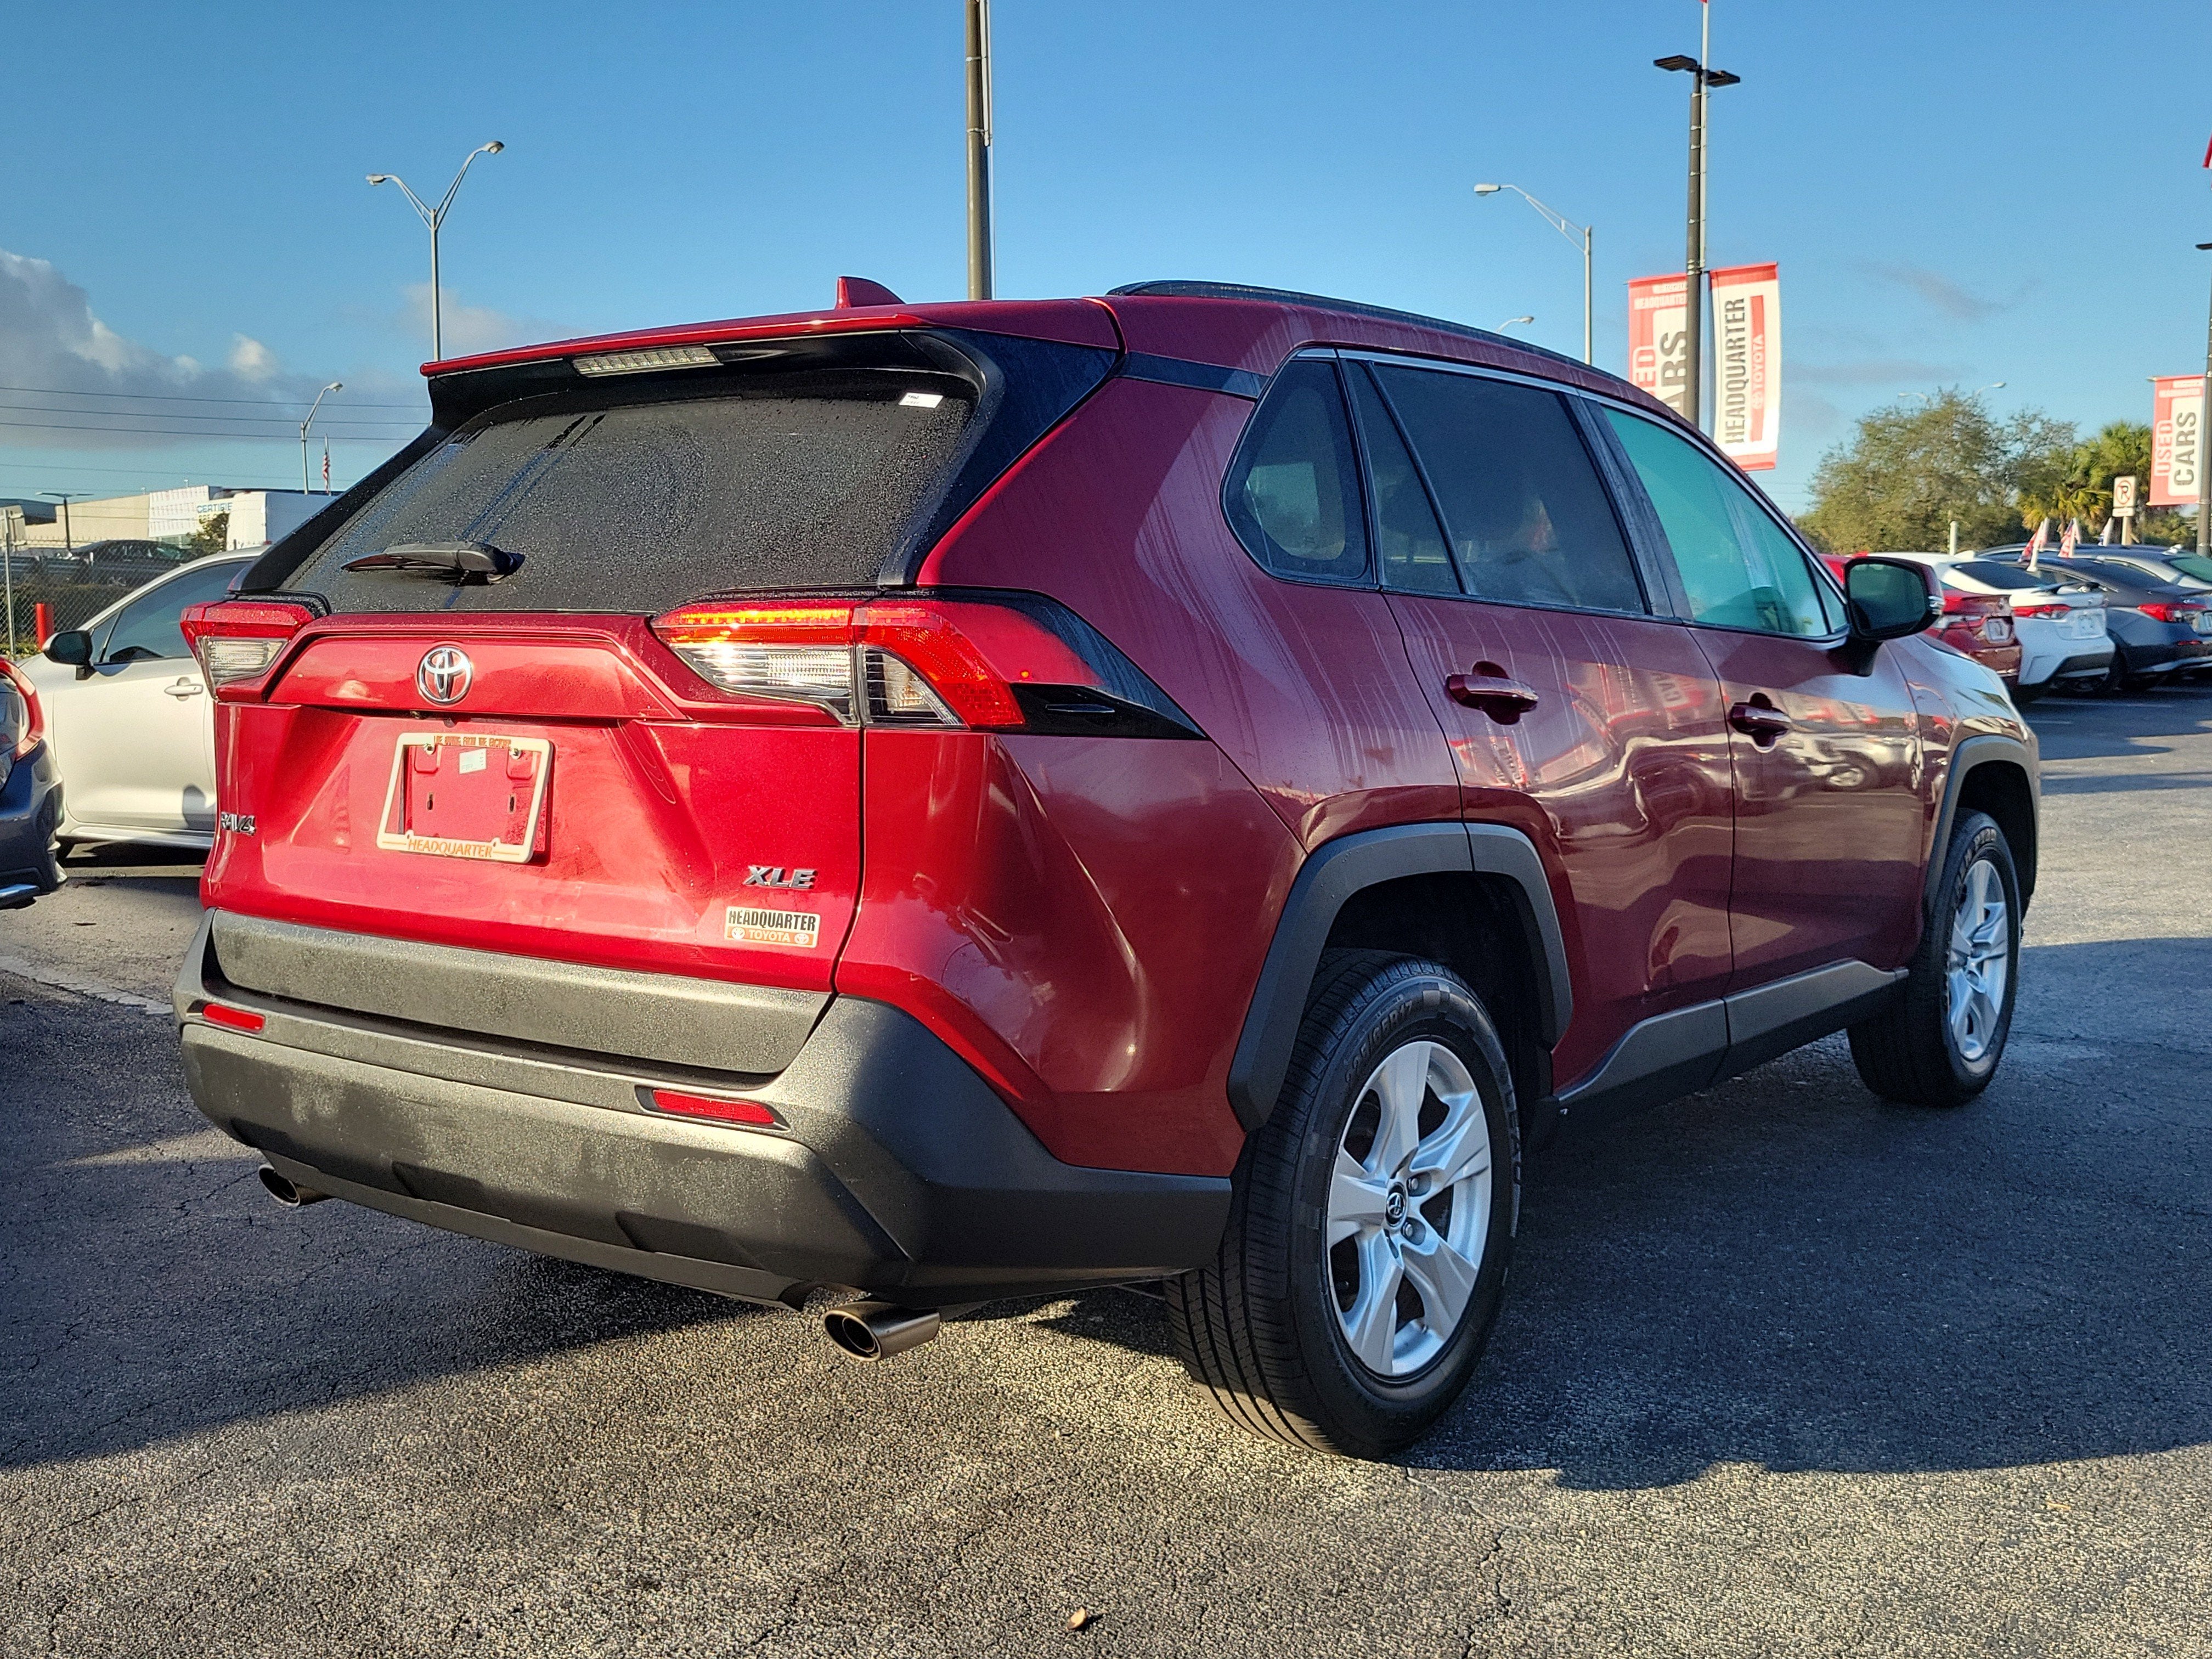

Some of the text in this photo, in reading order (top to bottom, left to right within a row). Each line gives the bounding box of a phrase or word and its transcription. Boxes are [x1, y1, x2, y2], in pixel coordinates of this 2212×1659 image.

[1634, 292, 1687, 310] HEADQUARTE
[1725, 298, 1749, 443] HEADQUARTER
[1752, 334, 1764, 389] TOYOTA
[2157, 423, 2172, 473] USED
[2173, 413, 2197, 486] CARS
[198, 503, 232, 513] CERTIFIE
[409, 839, 492, 857] HEADQUARTER
[743, 865, 818, 889] XLE
[729, 910, 816, 932] HEADQUARTER
[749, 930, 790, 943] TOYOTA
